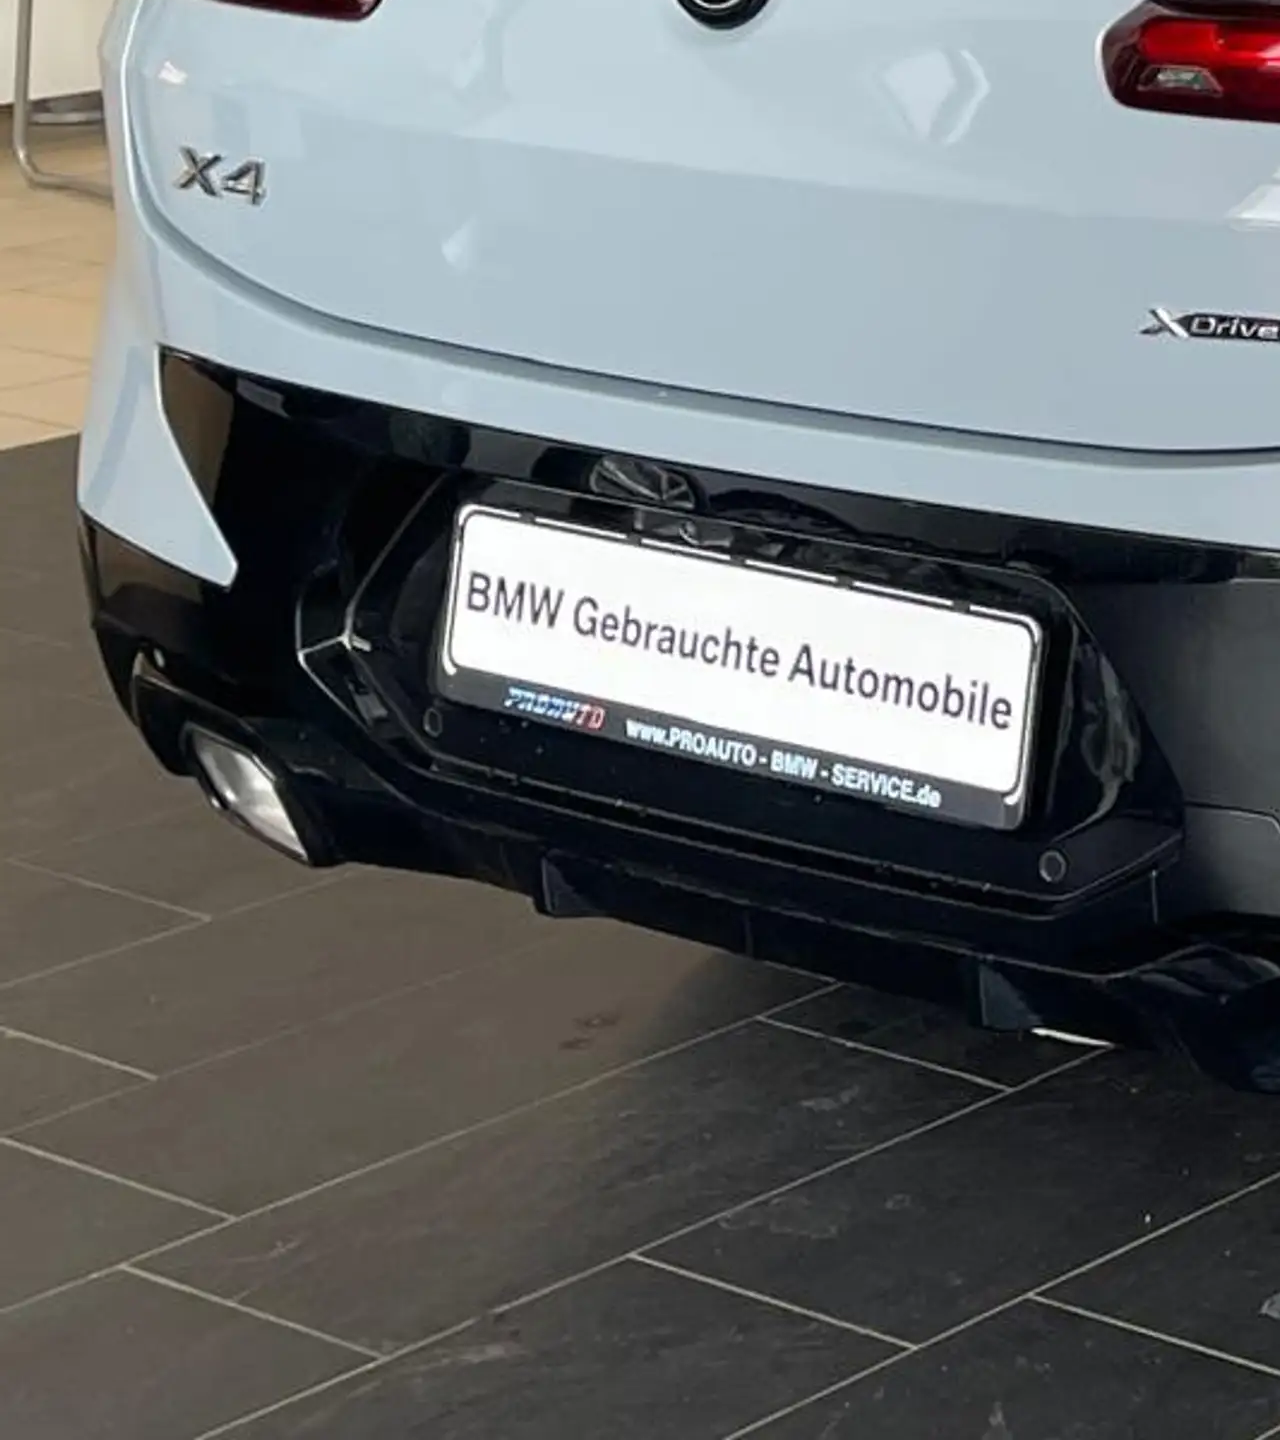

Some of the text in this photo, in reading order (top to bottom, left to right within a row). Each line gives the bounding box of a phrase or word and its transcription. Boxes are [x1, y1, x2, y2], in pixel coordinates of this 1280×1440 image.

[173, 146, 267, 206] X4
[467, 570, 1013, 730] BMW Gebrauchte Automobile
[625, 717, 756, 768] www.PROAUTO
[770, 749, 820, 782] BMW
[831, 762, 943, 809] SERVICE.de
